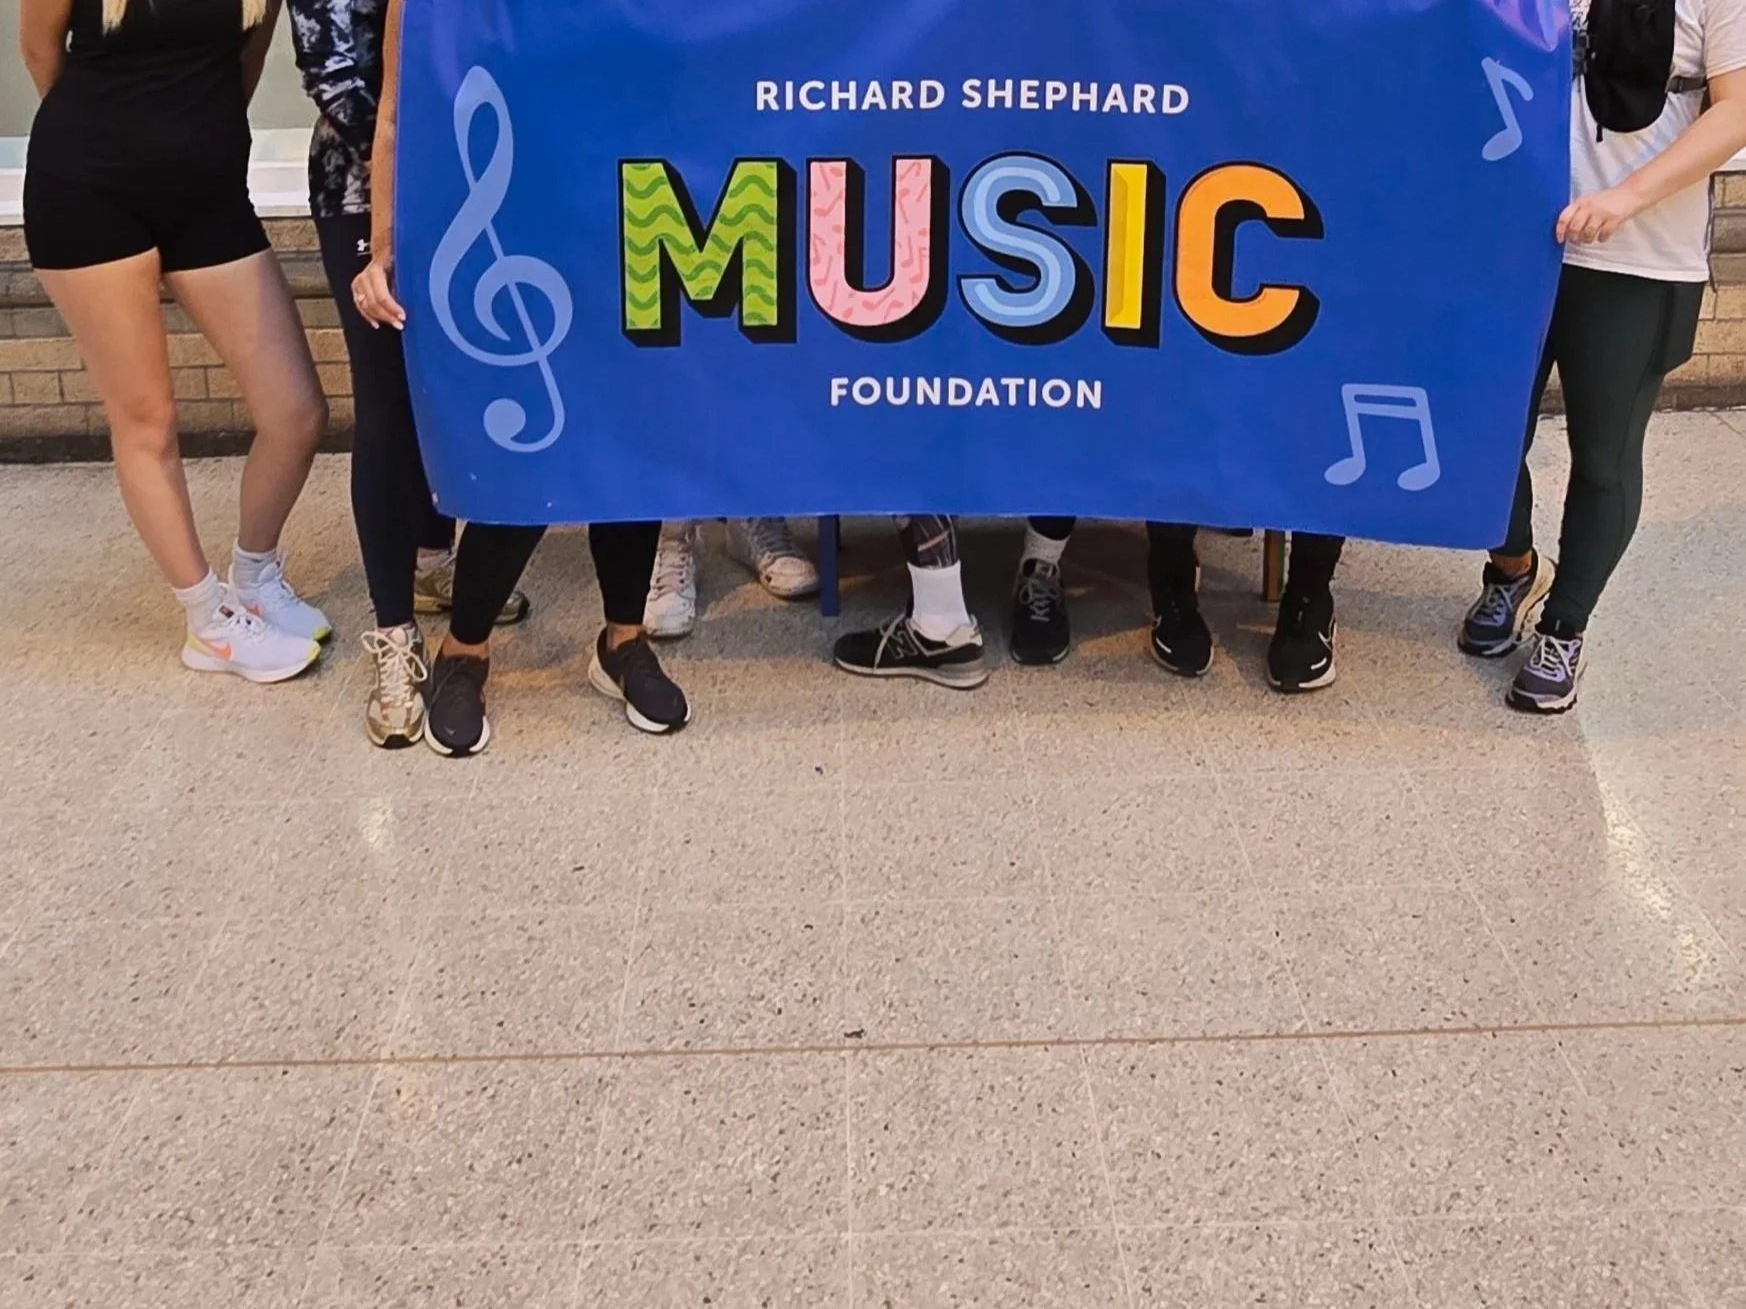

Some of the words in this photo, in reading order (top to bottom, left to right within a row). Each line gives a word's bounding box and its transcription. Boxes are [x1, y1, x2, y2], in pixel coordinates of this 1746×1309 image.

[756, 81, 945, 111] RICHARD
[961, 79, 1189, 114] SHEPHARD
[617, 152, 1324, 356] MUSIC
[830, 376, 1102, 409] FOUNDATION
